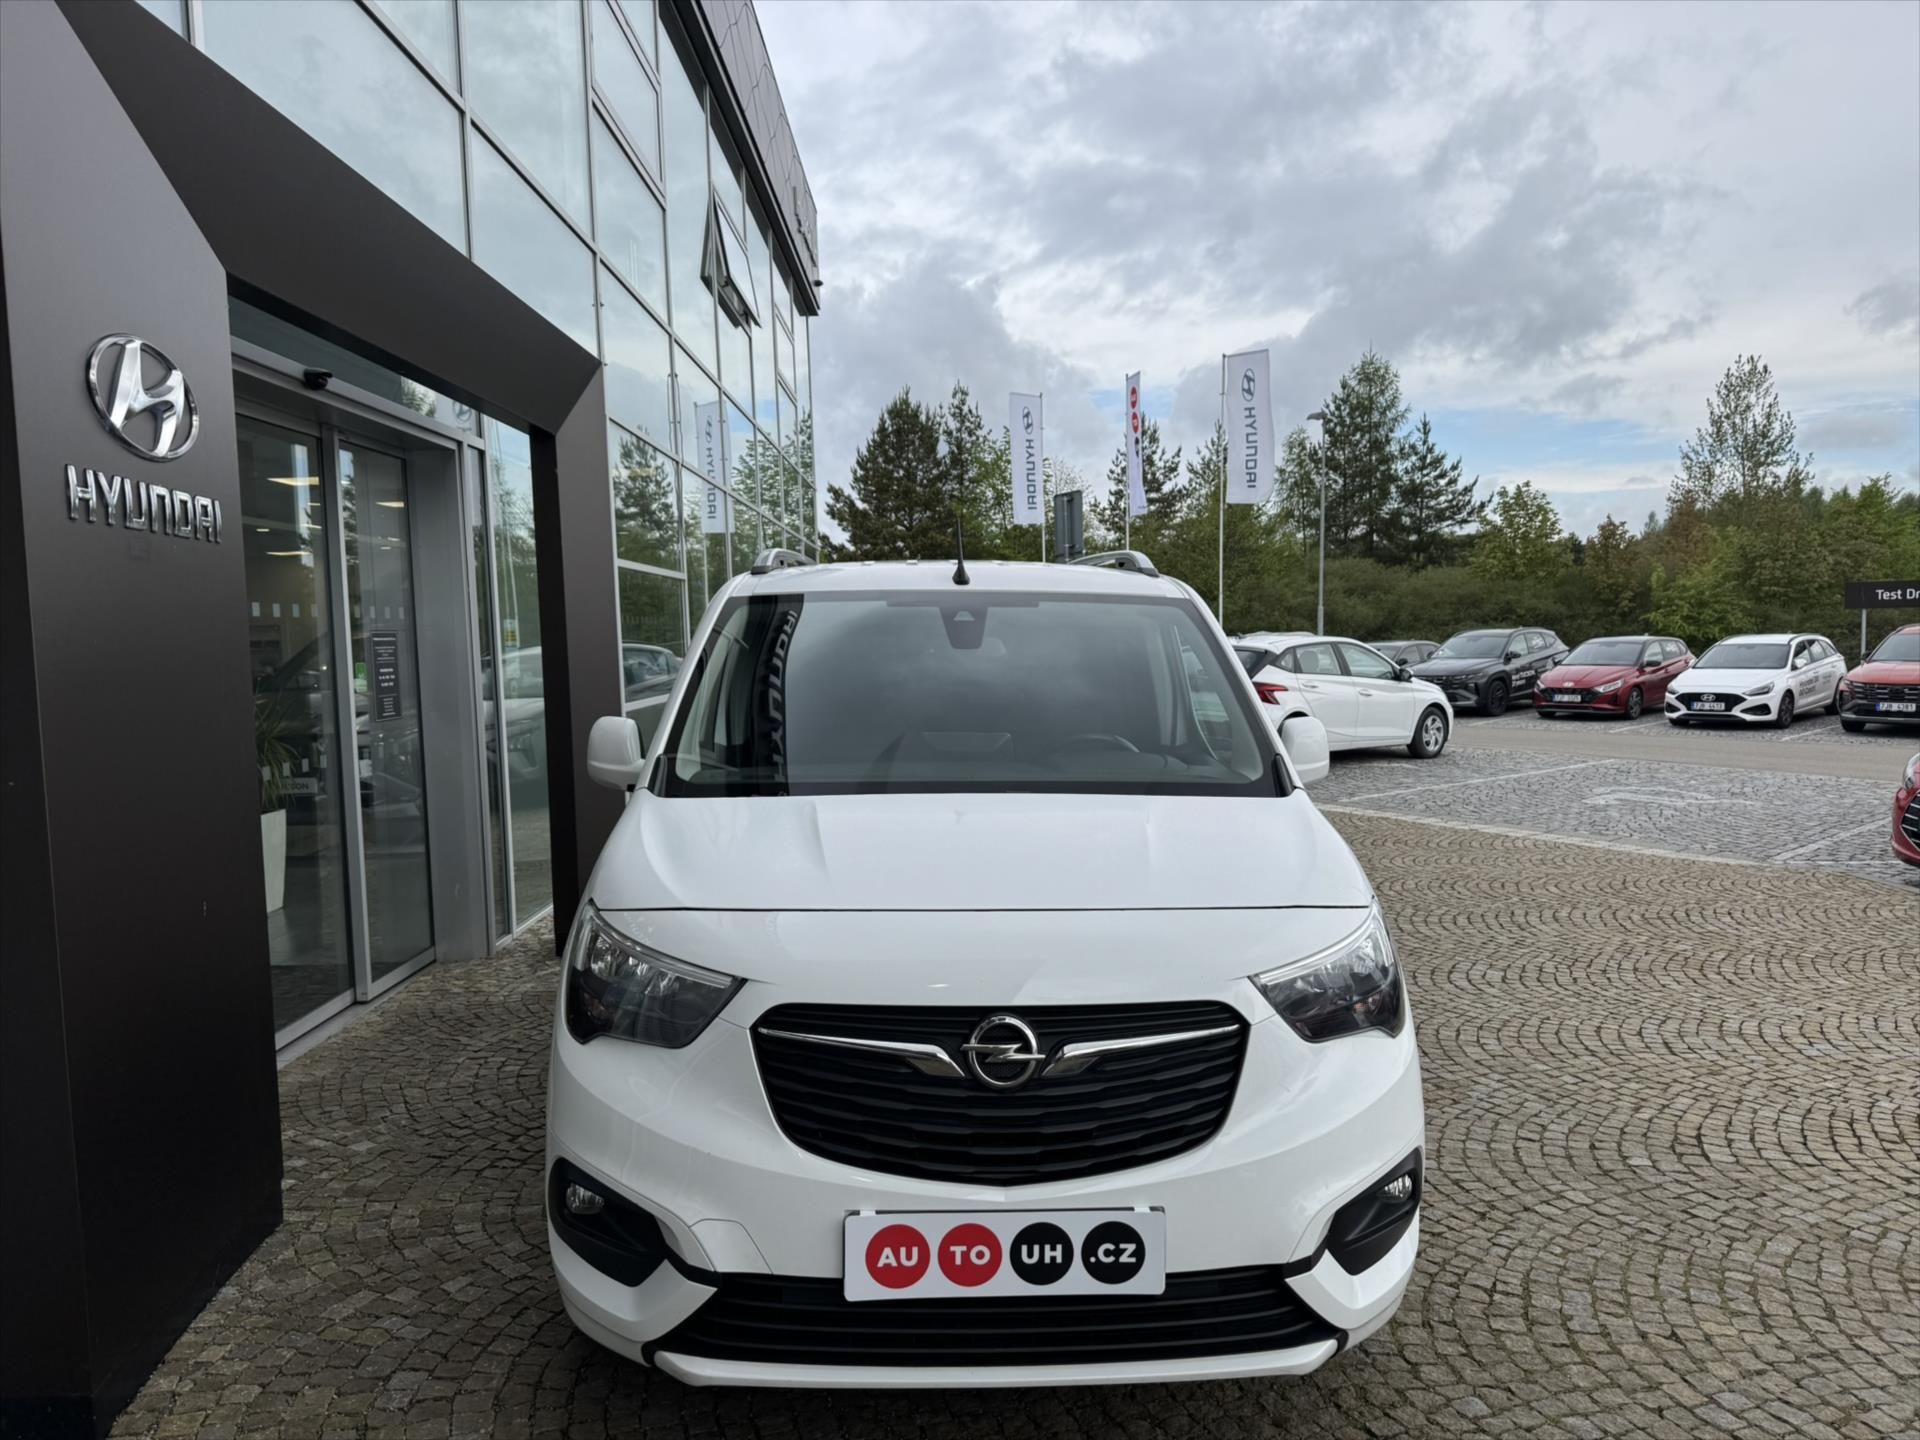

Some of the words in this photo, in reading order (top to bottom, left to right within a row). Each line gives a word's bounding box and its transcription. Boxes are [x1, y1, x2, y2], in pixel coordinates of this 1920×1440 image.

[1244, 406, 1258, 489] HYUNDAI
[65, 464, 223, 545] HYUNDAI
[1875, 588, 1903, 600] Test
[877, 1246, 919, 1268] AU
[950, 1244, 991, 1266] TO
[1021, 1243, 1063, 1264] UH
[1089, 1242, 1137, 1264] .CZ
